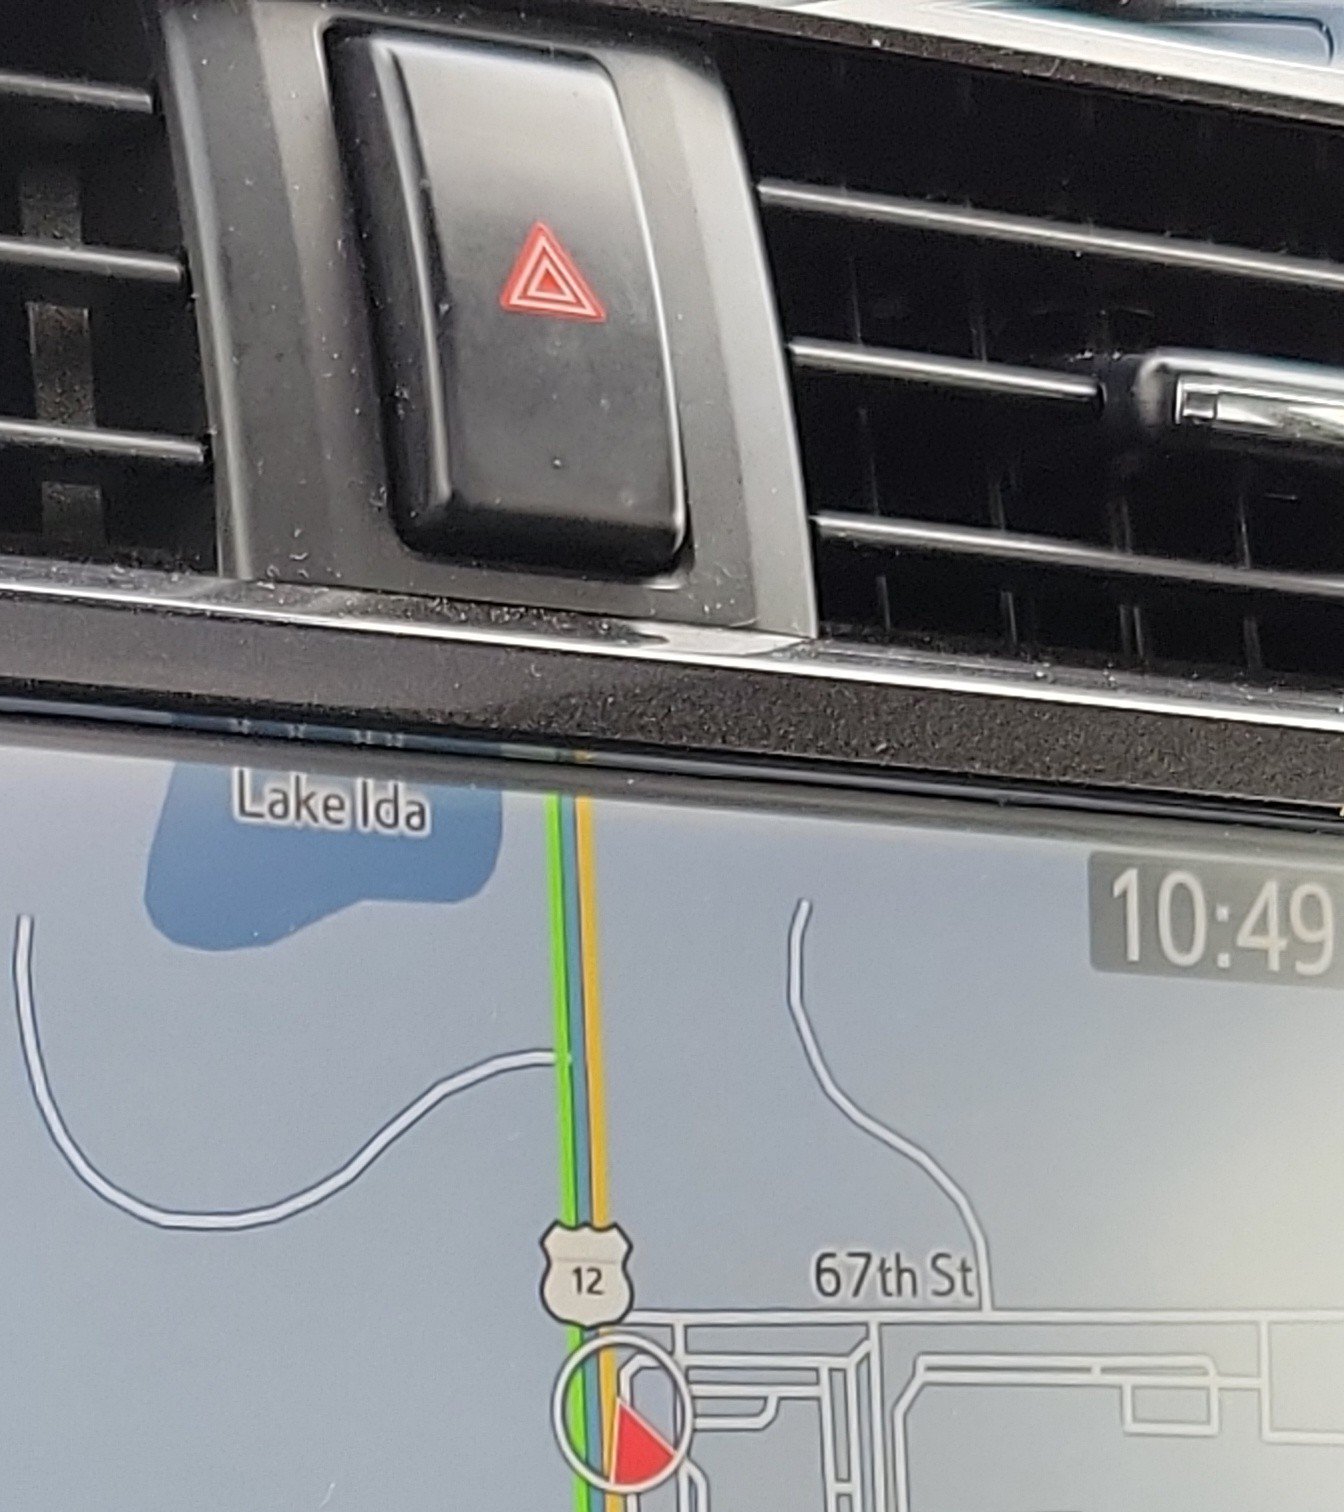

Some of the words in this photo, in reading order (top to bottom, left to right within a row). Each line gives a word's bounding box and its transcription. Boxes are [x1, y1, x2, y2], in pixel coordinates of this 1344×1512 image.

[233, 766, 346, 828] Lake
[360, 778, 430, 834] Ida
[1112, 867, 1335, 976] 10:49
[571, 1267, 604, 1298] 12
[813, 1252, 920, 1300] 67th
[930, 1253, 976, 1300] St
